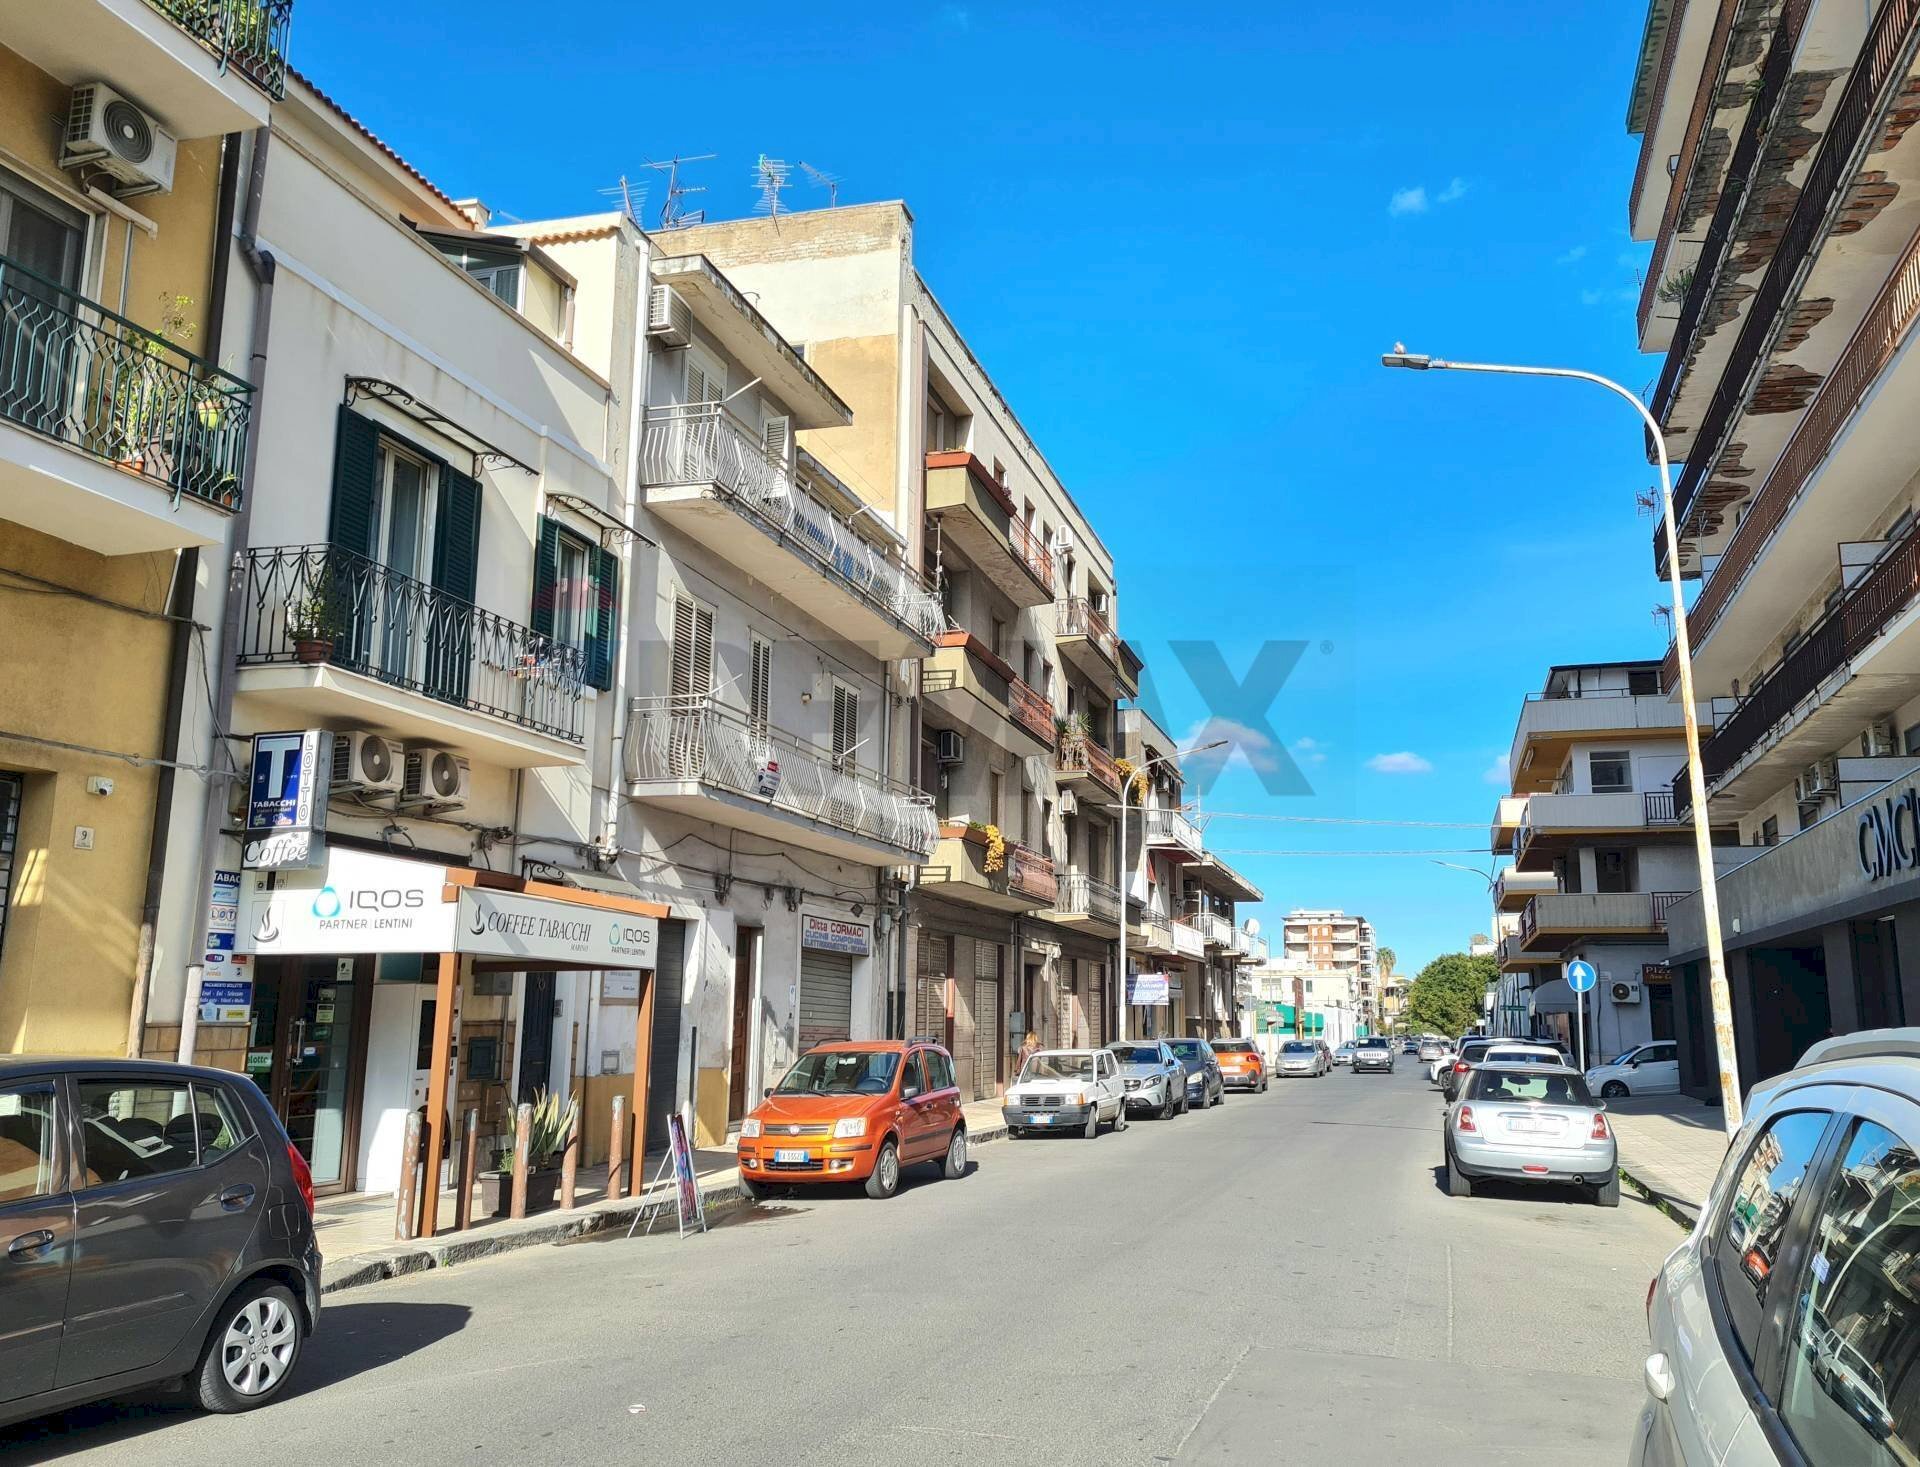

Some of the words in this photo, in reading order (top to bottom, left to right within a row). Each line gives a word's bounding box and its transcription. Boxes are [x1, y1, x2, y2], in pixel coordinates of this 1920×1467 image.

[298, 734, 313, 821] LOTTO
[253, 800, 296, 808] TABACCHI
[244, 839, 308, 867] Coffee
[350, 889, 424, 912] IQOS
[319, 919, 368, 930] PARTNER
[374, 918, 413, 929] LENTINI
[488, 911, 535, 936] COFFEE
[538, 917, 592, 942] TABACCHI
[831, 922, 864, 938] CORMACI
[622, 928, 650, 944] IQOS
[611, 946, 629, 955] PARTNER
